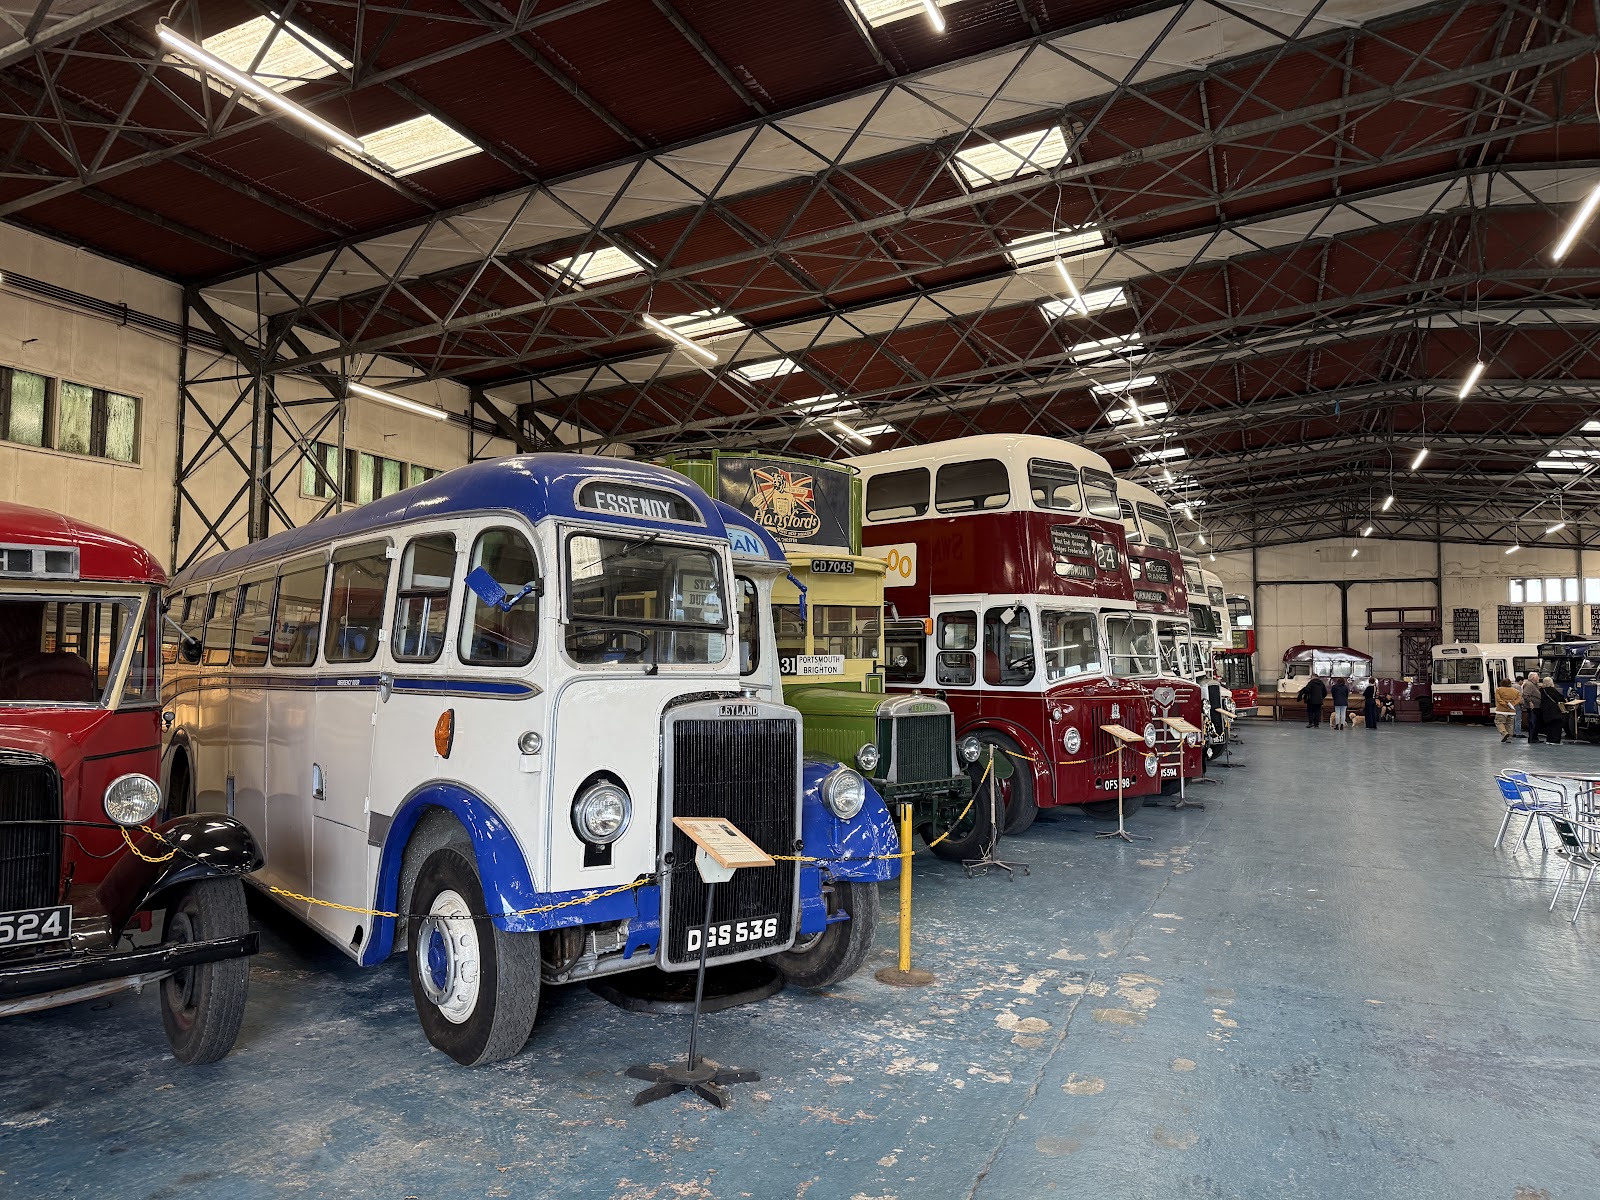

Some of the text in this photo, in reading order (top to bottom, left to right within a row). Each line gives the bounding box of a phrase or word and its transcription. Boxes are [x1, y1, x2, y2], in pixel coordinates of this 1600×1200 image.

[594, 491, 671, 519] ESSENDY
[753, 509, 818, 529] Hansfords
[730, 535, 759, 553] AN
[813, 561, 853, 573] CD 7045
[879, 549, 912, 578] OO
[1098, 547, 1116, 569] 24
[1147, 573, 1168, 581] RANGE
[780, 656, 840, 674] 31 PORTSMOUTH
[803, 666, 838, 674] BRIGHTON
[719, 704, 759, 716] LEYLAND
[1105, 781, 1118, 790] OFS
[0, 911, 63, 943] 524
[687, 918, 777, 951] DGS 536
